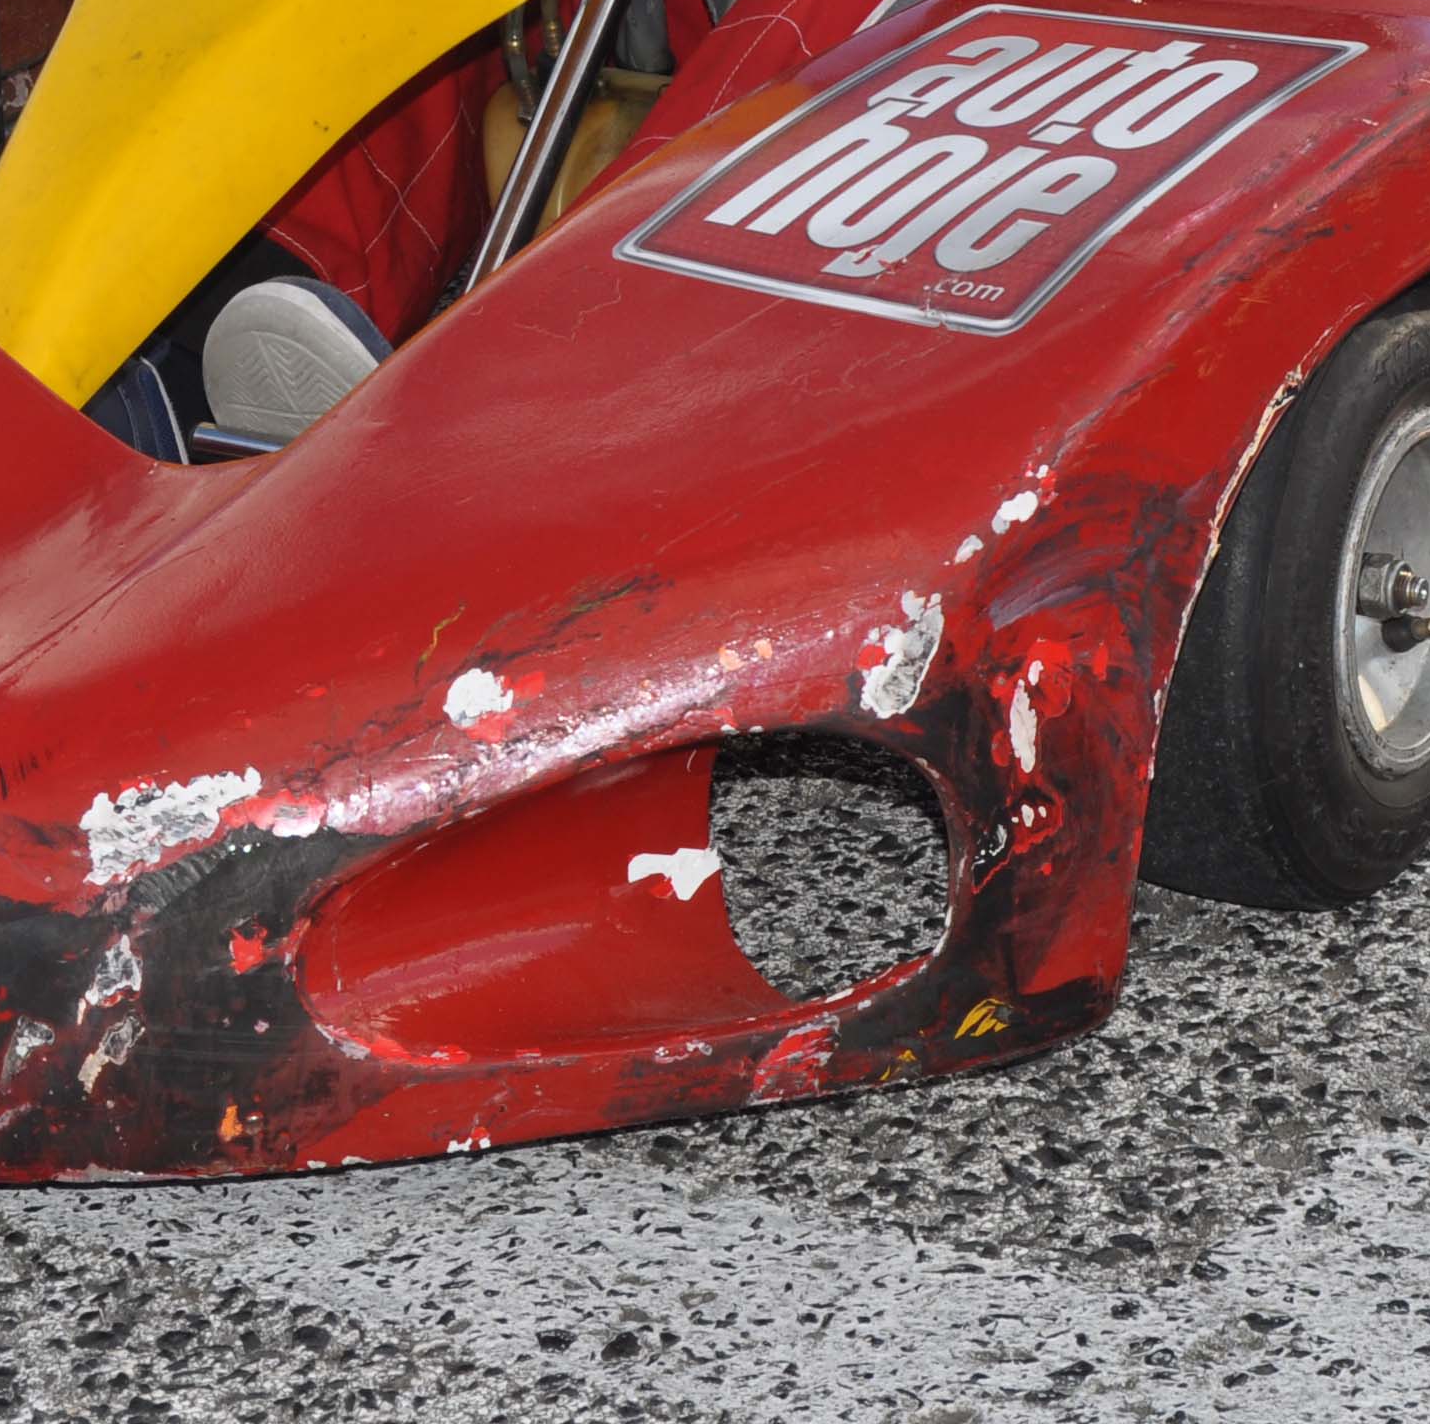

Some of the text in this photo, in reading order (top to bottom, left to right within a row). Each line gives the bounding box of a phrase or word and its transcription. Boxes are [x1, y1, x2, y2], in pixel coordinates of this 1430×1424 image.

[867, 35, 1259, 150] auto
[704, 99, 1118, 277] hoje
[922, 277, 1005, 302] .com
